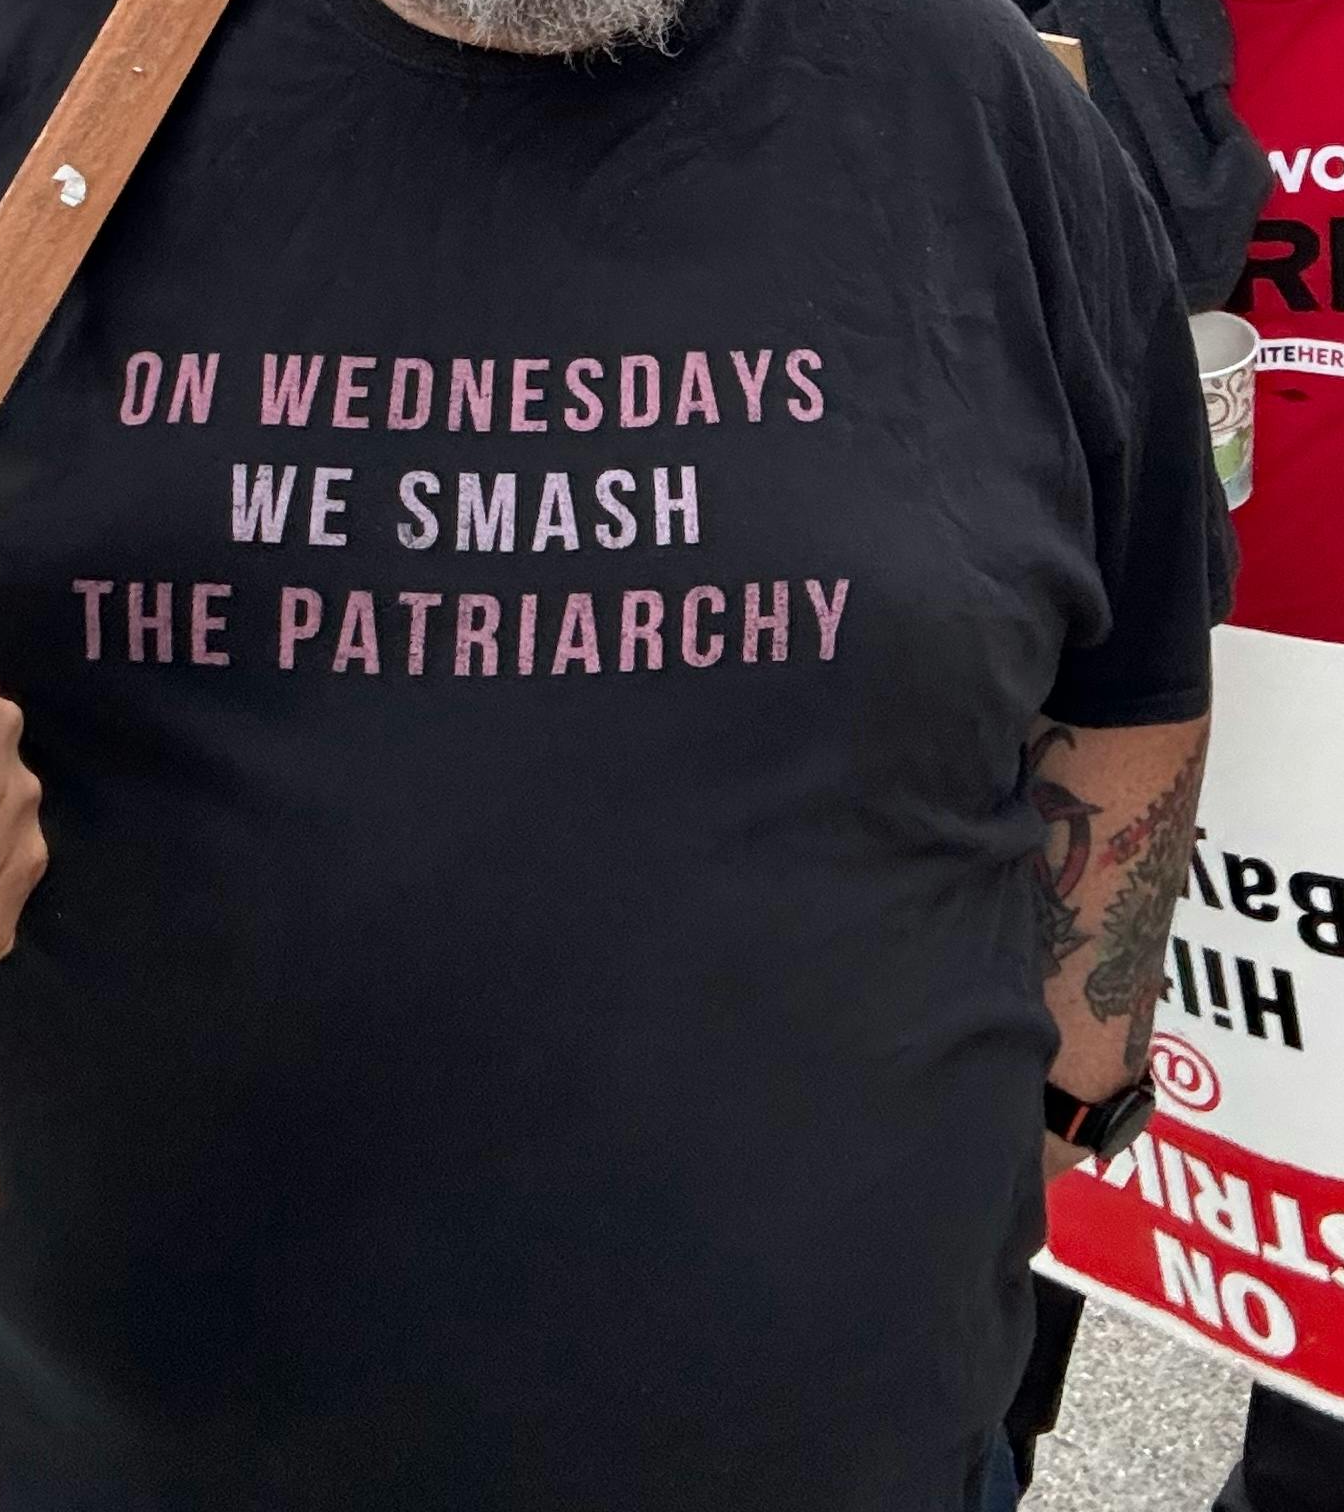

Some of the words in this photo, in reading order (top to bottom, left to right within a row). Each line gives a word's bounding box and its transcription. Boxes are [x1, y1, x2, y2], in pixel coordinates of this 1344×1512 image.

[120, 350, 220, 426] ON
[260, 348, 825, 432] WEDNESDAYS
[231, 463, 353, 546] WE
[396, 464, 701, 553] SMASH
[71, 579, 233, 666] THE
[278, 578, 850, 677] PATRIARCHY
[1158, 935, 1304, 1052] Hil
[1152, 1226, 1296, 1359] ON
